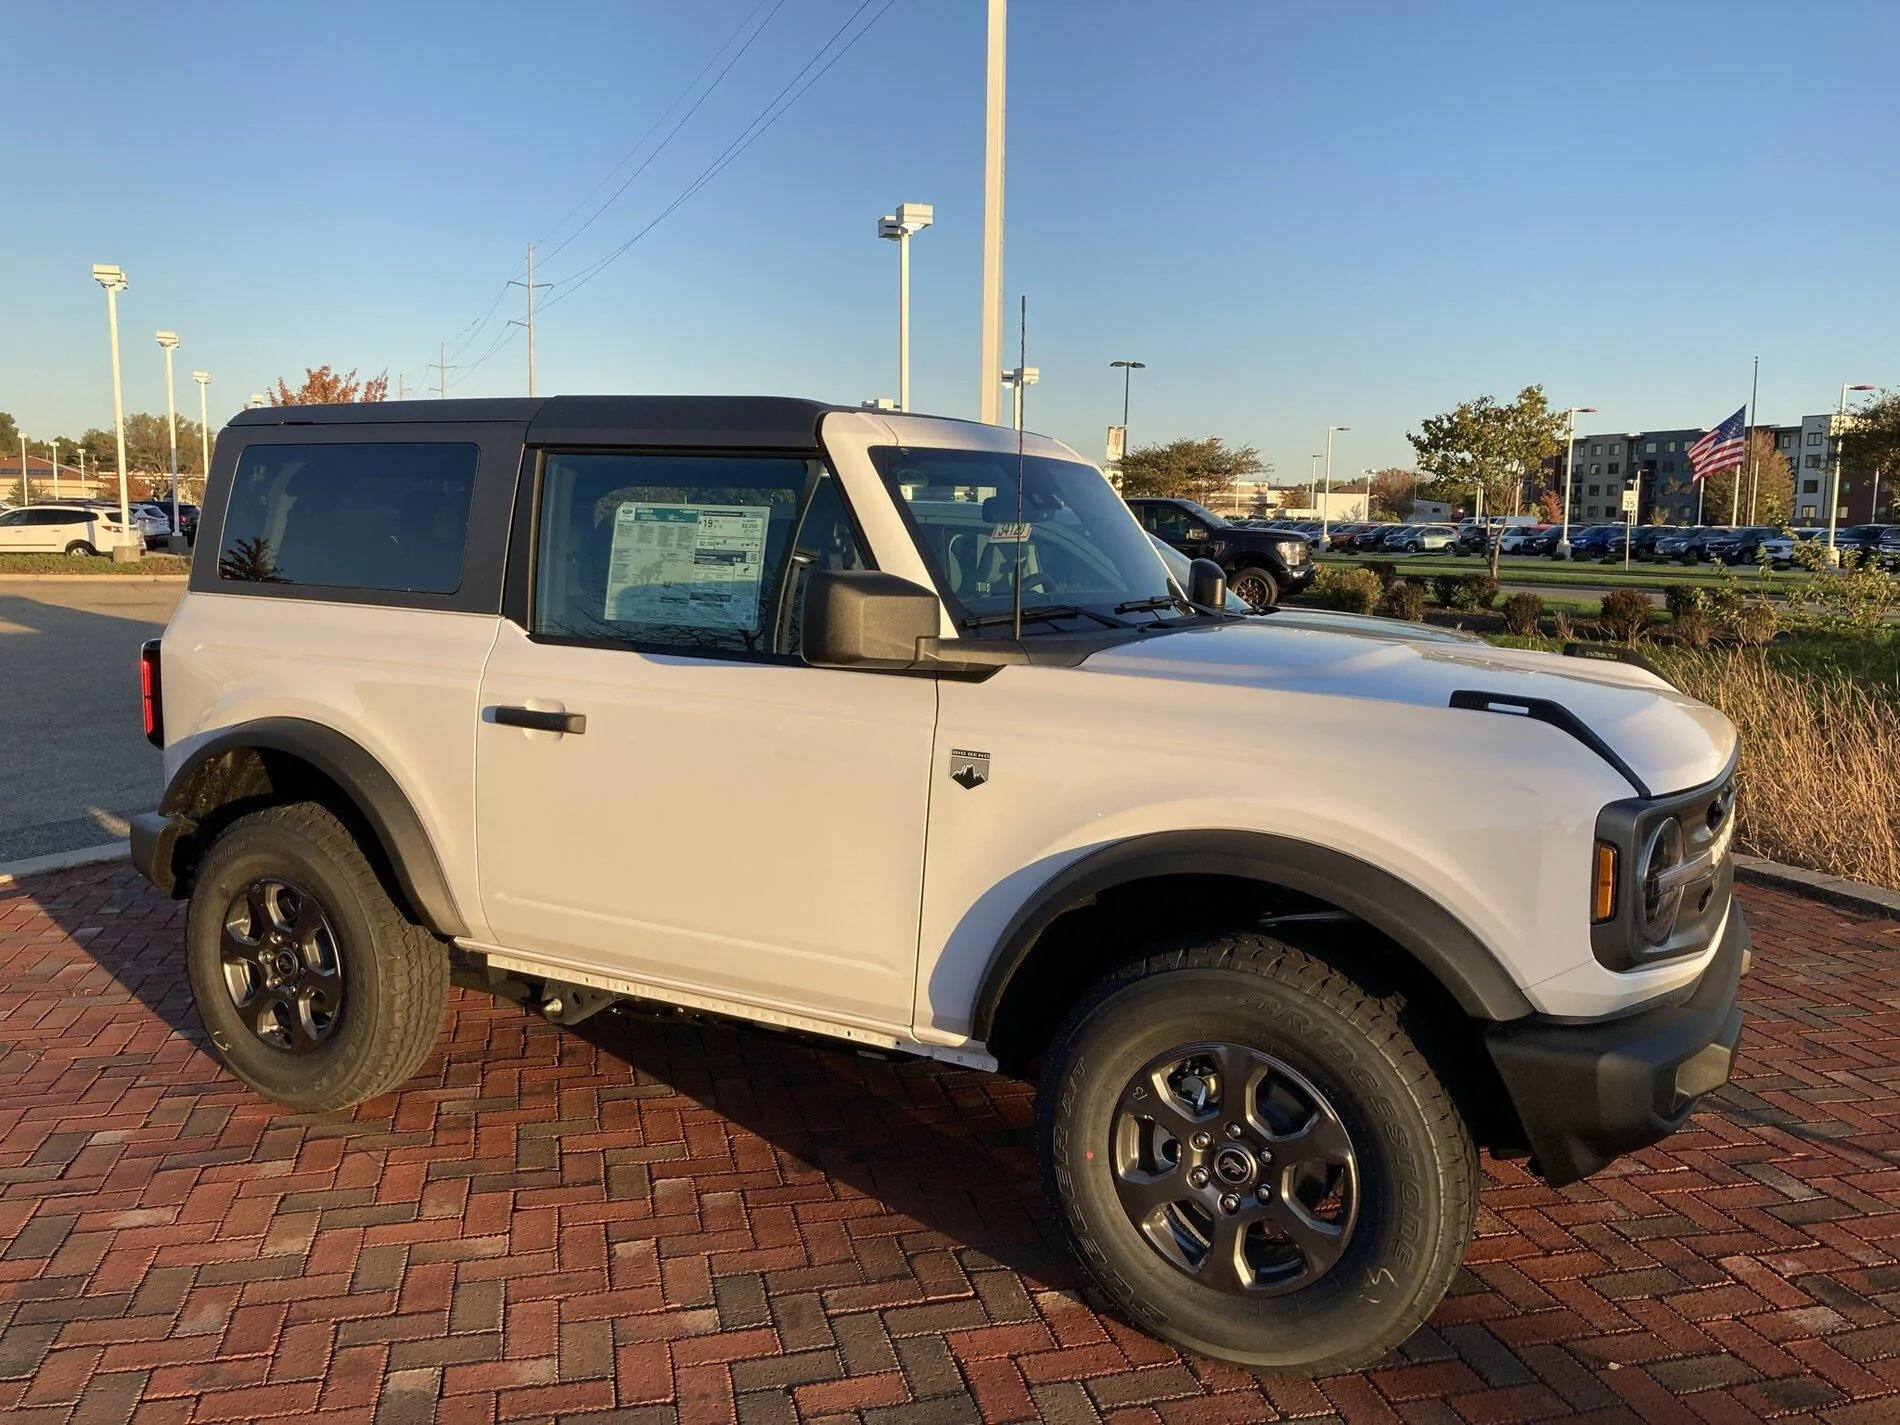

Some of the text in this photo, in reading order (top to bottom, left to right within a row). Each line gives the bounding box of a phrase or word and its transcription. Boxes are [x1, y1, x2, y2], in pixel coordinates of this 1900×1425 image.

[1624, 500, 1636, 508] 35
[702, 519, 714, 528] 19
[1239, 991, 1425, 1272] BRIDGESTONE
